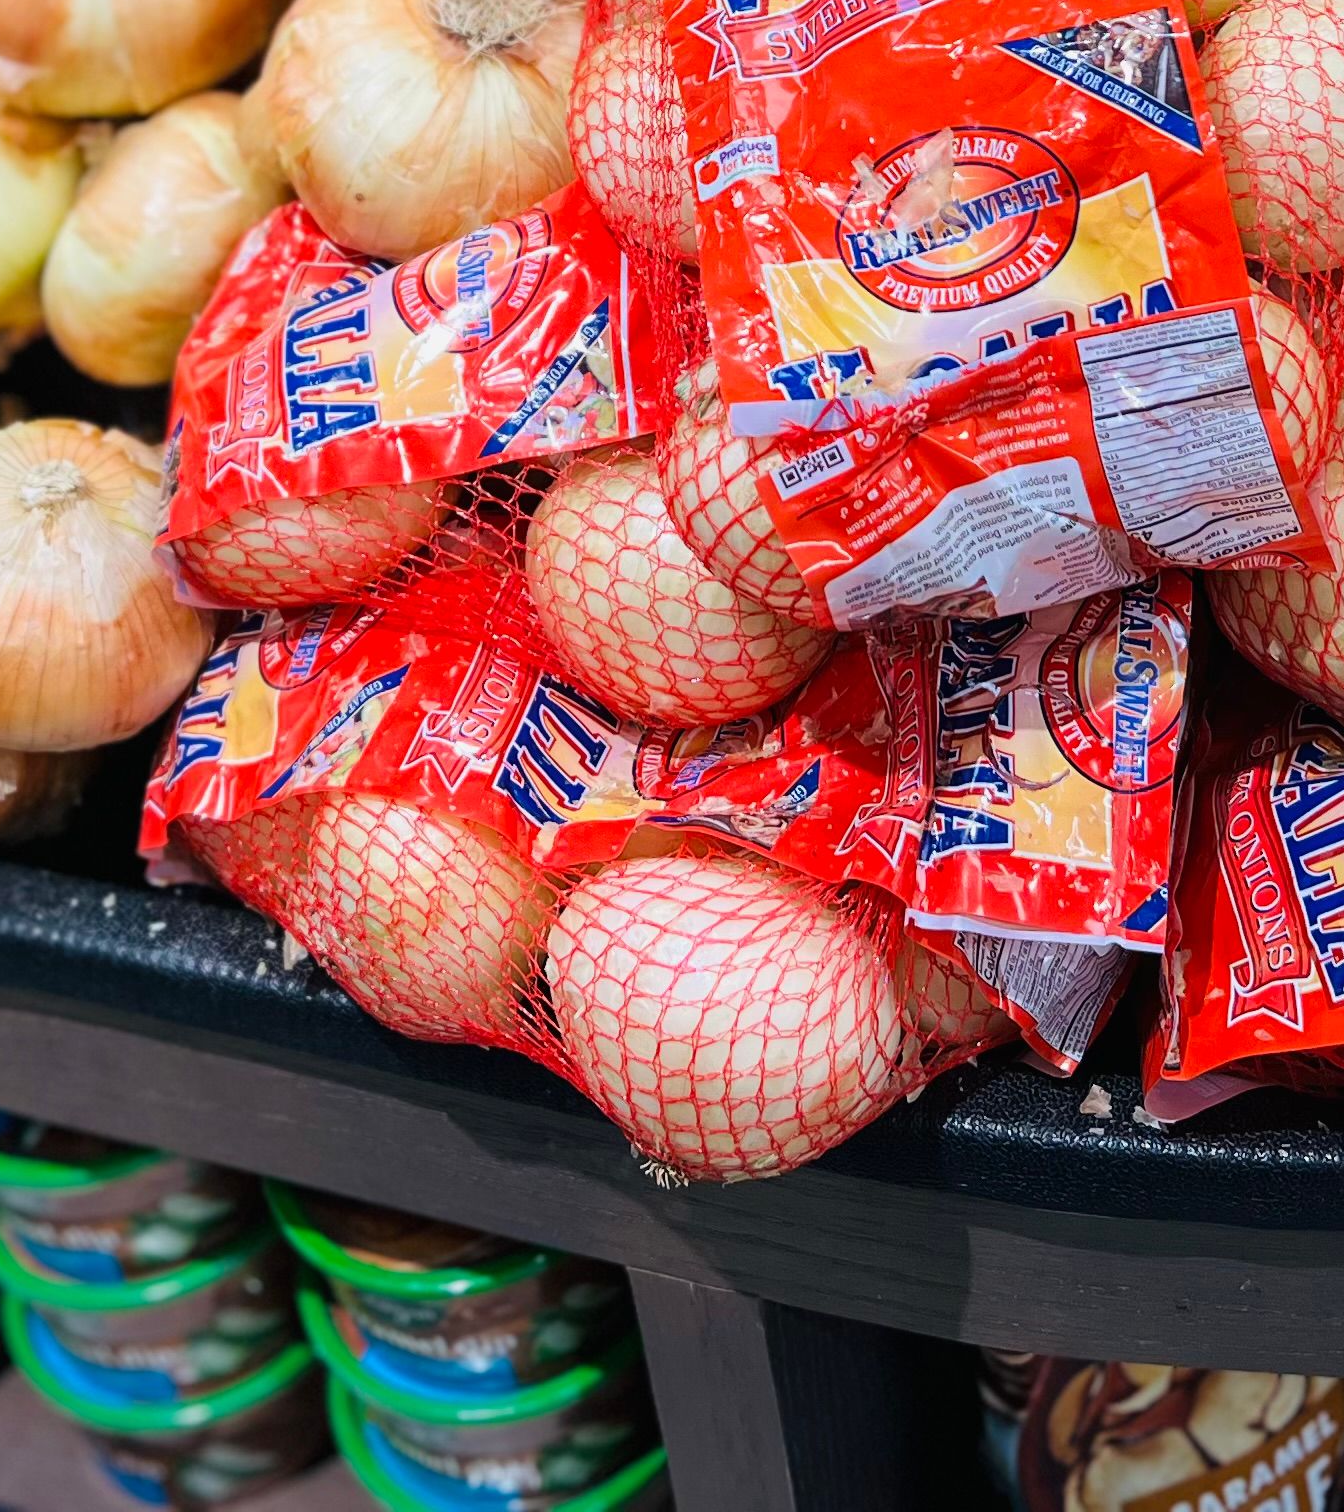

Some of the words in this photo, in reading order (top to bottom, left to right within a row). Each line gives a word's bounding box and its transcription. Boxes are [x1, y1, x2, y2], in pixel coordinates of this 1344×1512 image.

[1028, 44, 1072, 80] GREAT
[1071, 64, 1101, 91] FOR
[1100, 79, 1168, 126] GRILLING
[719, 138, 773, 165] Produce
[877, 275, 981, 308] PREMIUM
[982, 230, 1061, 293] QUALITY
[543, 360, 568, 386] FOR
[1225, 446, 1271, 466] Cholesterol
[1219, 491, 1285, 508] Calories
[1255, 507, 1293, 519] Serving
[1236, 529, 1251, 540] per
[1251, 522, 1289, 536] servings
[1208, 526, 1299, 560] Nutrition
[1230, 554, 1281, 570] VIDALIA
[344, 679, 384, 716] GREAT
[321, 710, 348, 739] FOR
[1047, 668, 1092, 756] QUALITY
[1226, 809, 1298, 971] ONIONS
